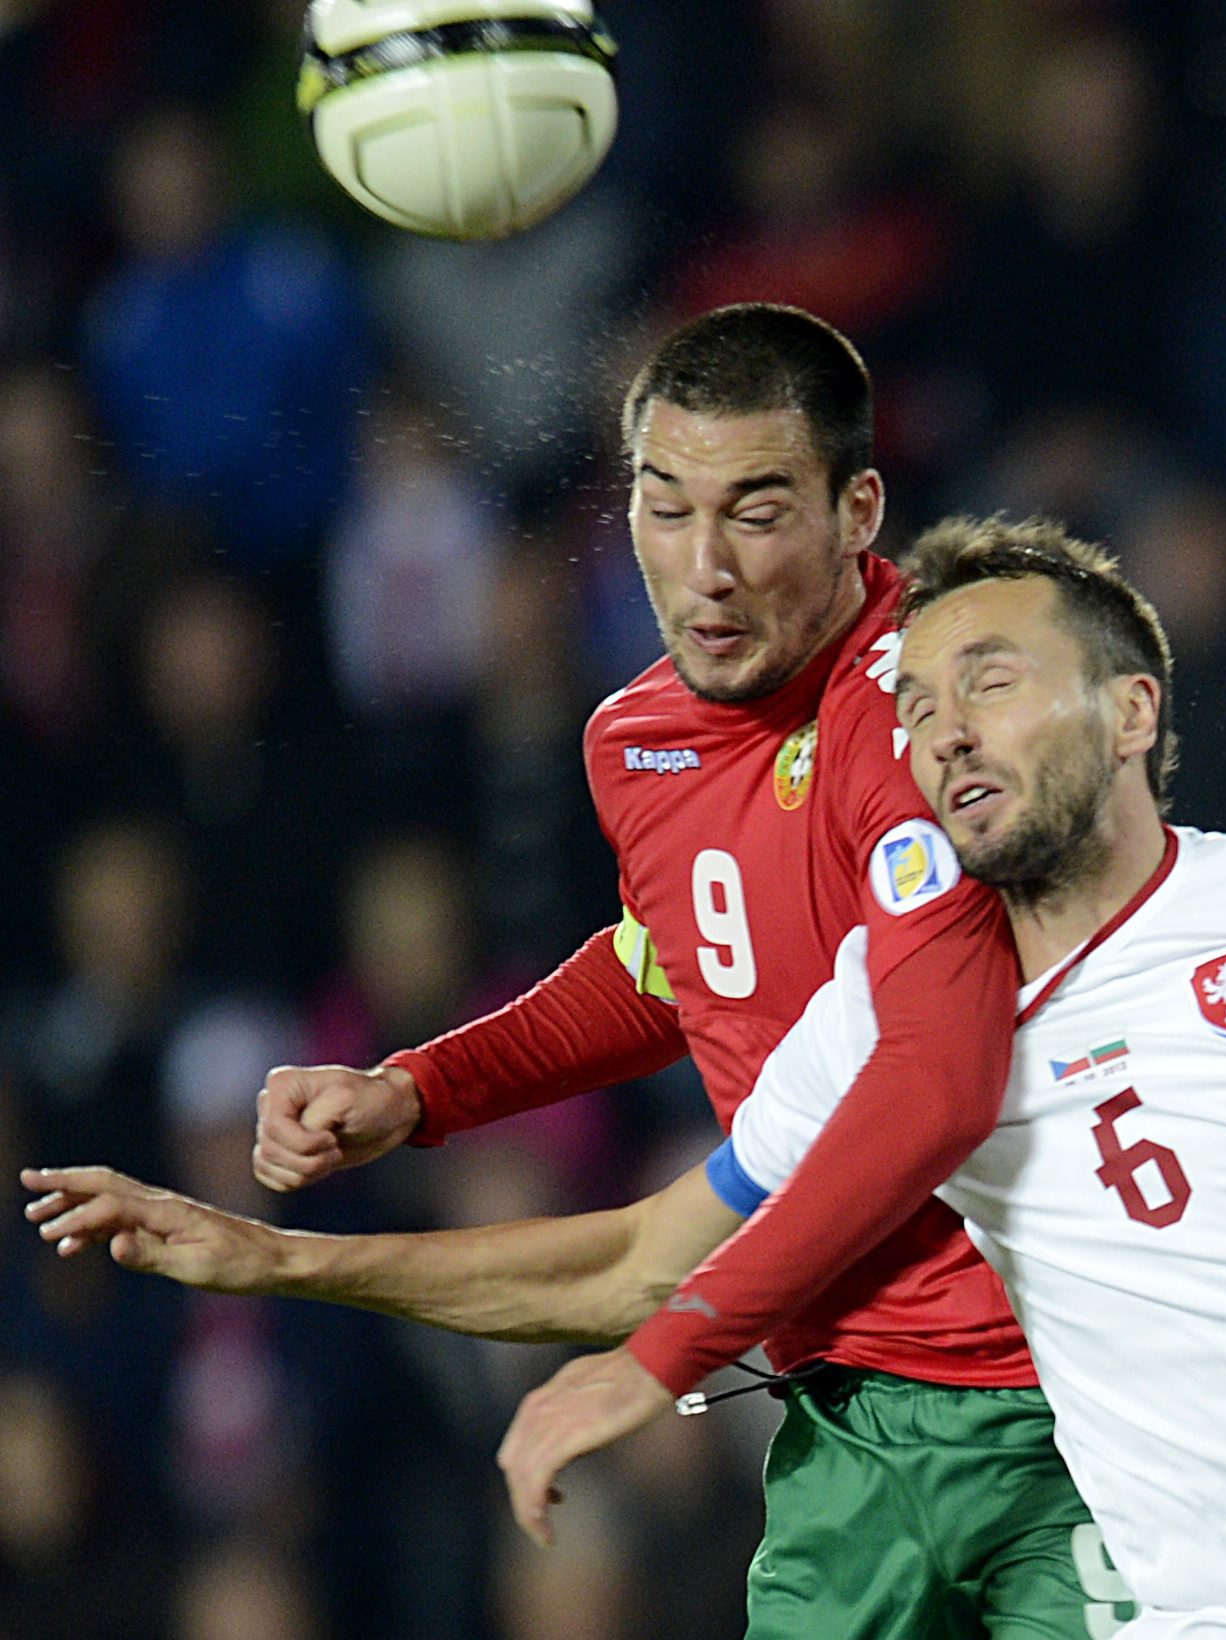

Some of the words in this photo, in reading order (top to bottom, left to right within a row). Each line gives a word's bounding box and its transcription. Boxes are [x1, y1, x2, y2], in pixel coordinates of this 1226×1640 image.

[623, 746, 702, 775] Kappa
[691, 848, 757, 999] 9
[1091, 1086, 1192, 1229] 6
